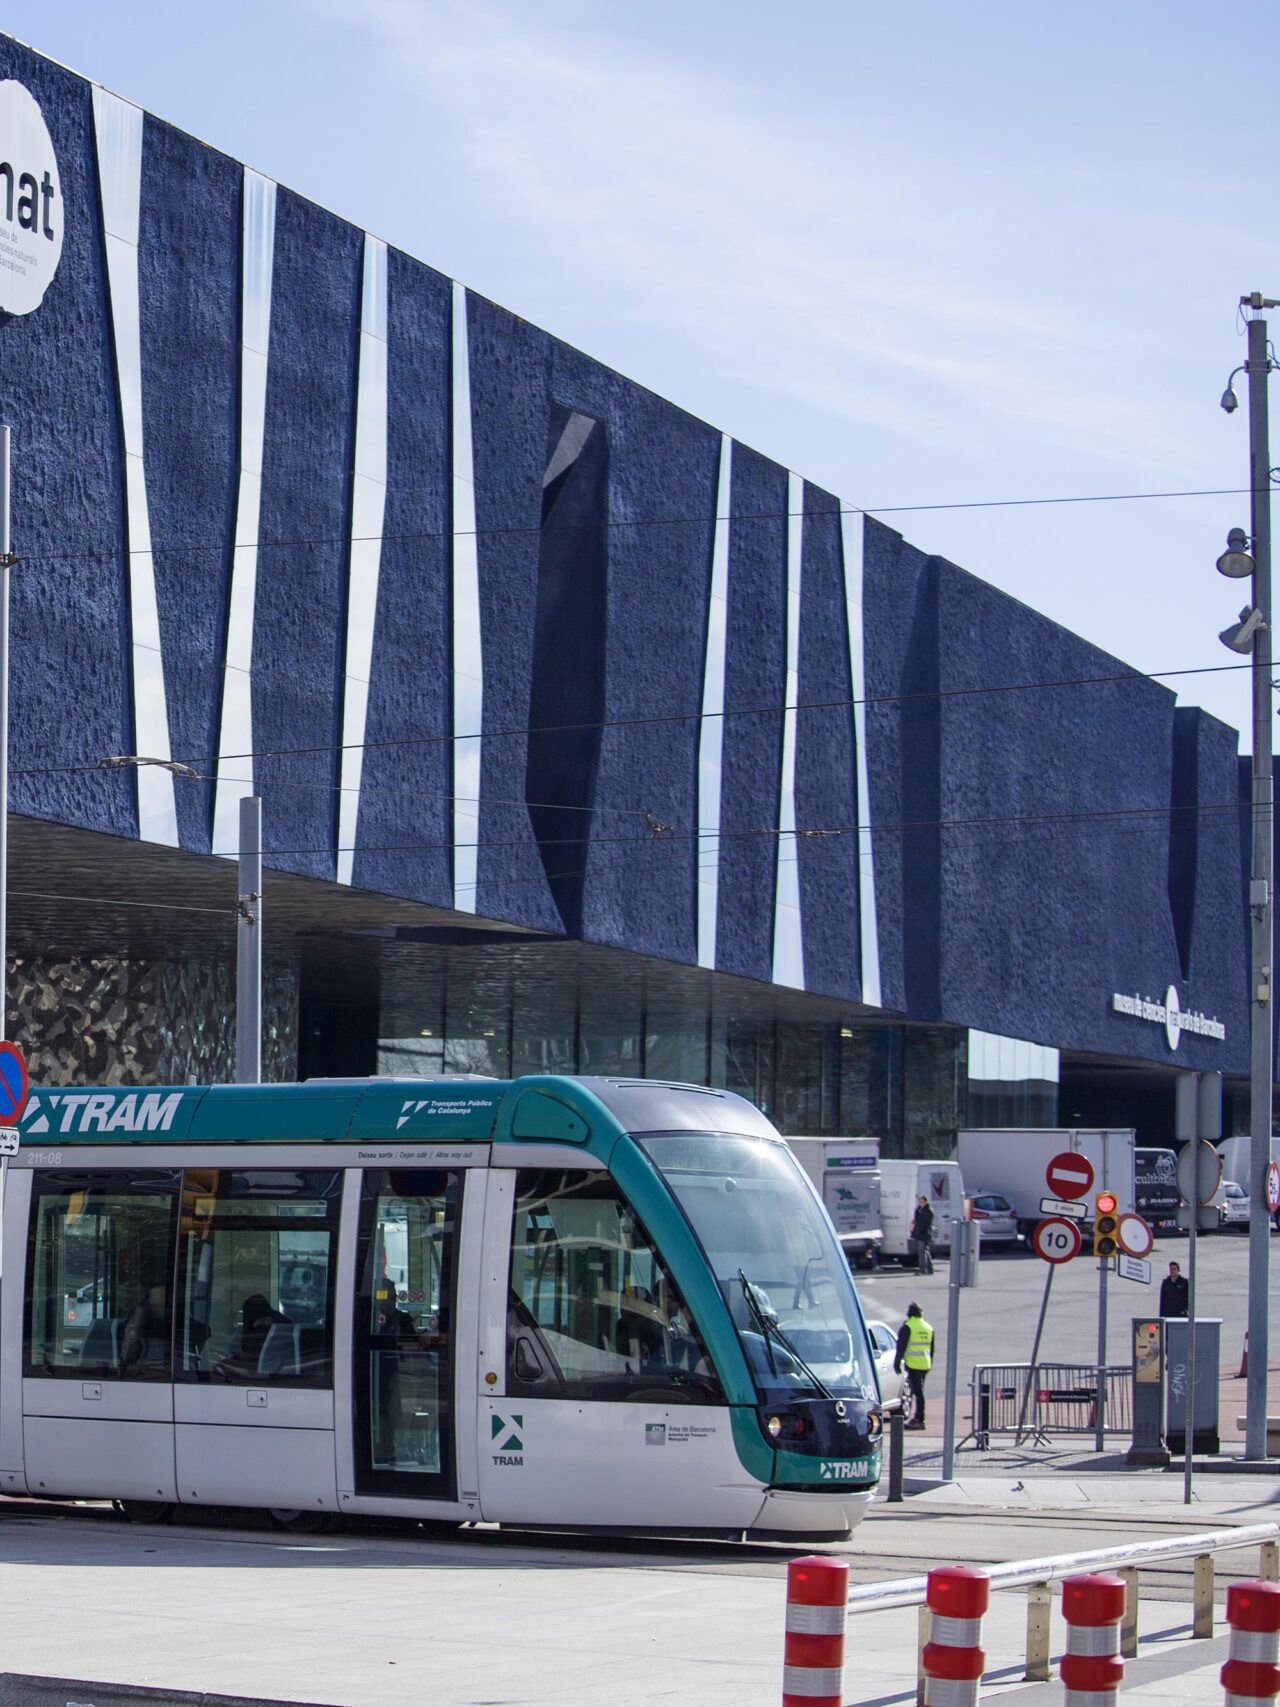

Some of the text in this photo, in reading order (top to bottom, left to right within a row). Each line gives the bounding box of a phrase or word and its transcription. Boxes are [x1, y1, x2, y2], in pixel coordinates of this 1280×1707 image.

[431, 1100, 466, 1108] Transports
[59, 1093, 184, 1133] TRAM
[437, 1107, 472, 1115] Catalunya
[27, 1152, 62, 1165] 211-08
[358, 1151, 377, 1159] Deixeu
[378, 1151, 393, 1159] sortir
[1046, 1231, 1068, 1249] 10
[860, 1385, 875, 1400] 08
[689, 1425, 716, 1433] Barcelona
[492, 1456, 524, 1466] TRAM
[833, 1461, 868, 1479] TRAM
